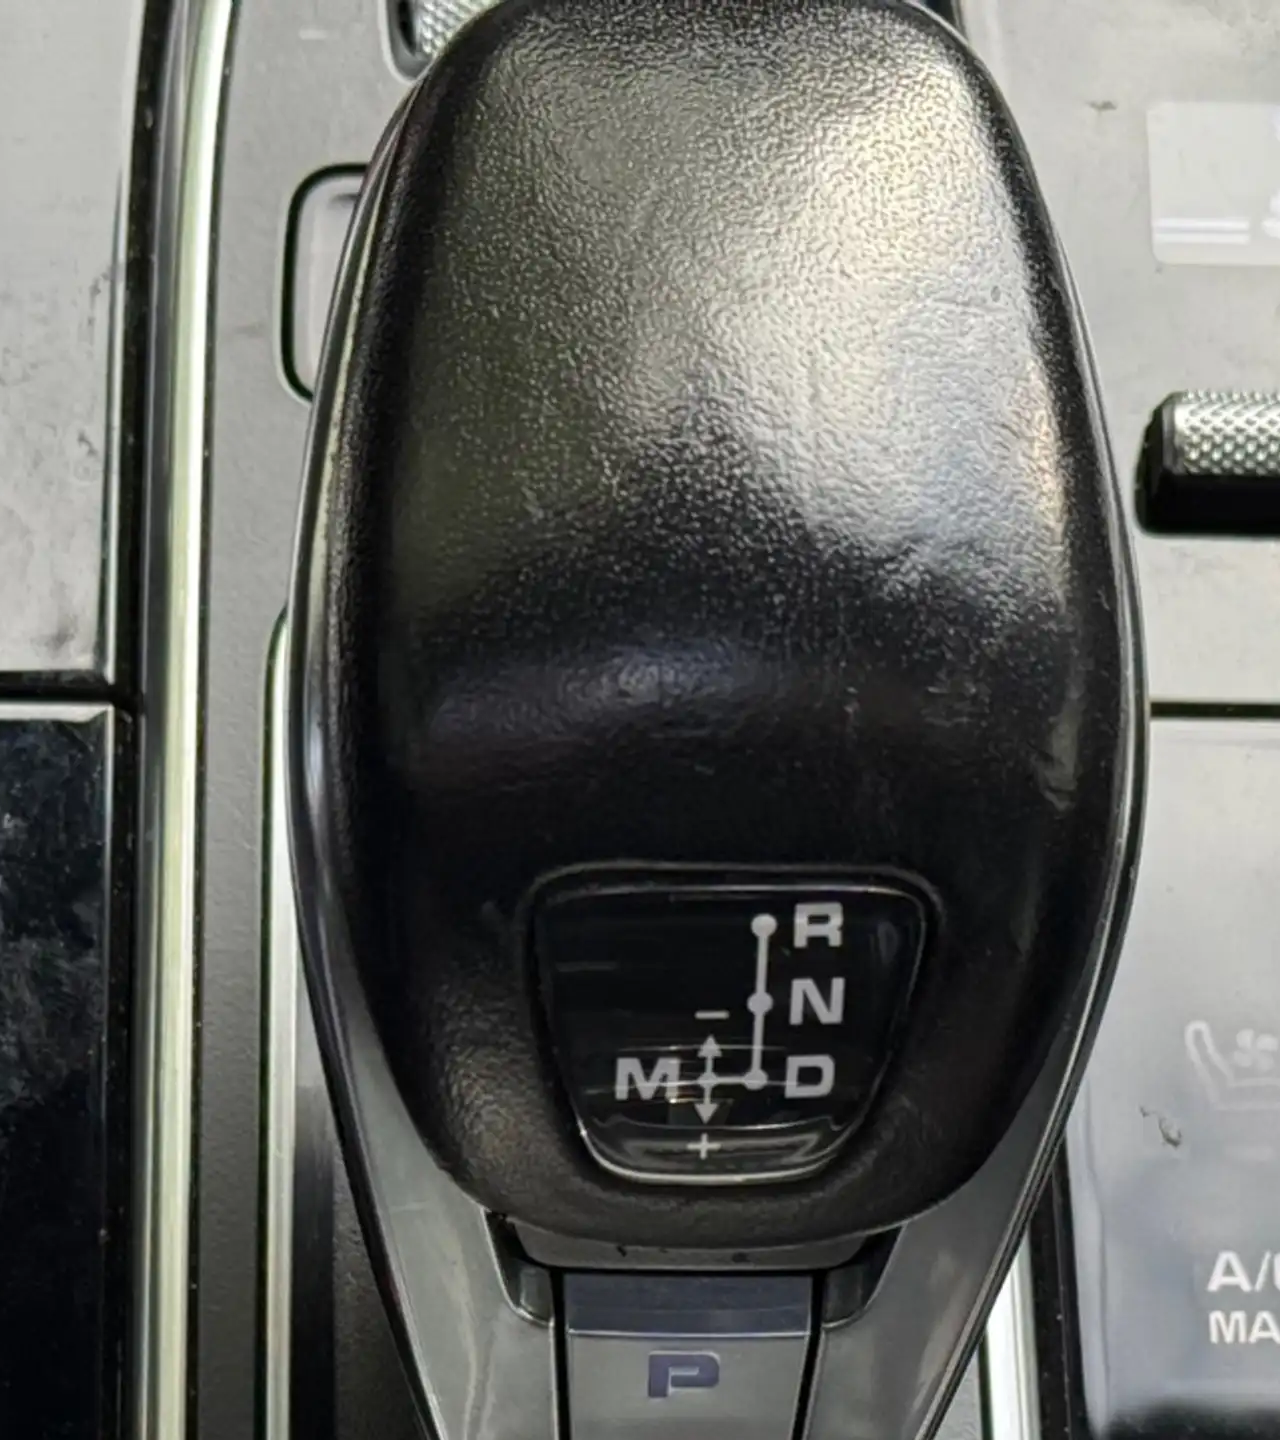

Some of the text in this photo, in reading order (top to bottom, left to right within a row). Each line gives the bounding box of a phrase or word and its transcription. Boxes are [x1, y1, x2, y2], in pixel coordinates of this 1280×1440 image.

[793, 902, 844, 948] R
[789, 977, 845, 1025] N
[614, 1057, 681, 1101] M
[784, 1054, 835, 1099] D
[648, 1350, 720, 1398] P
